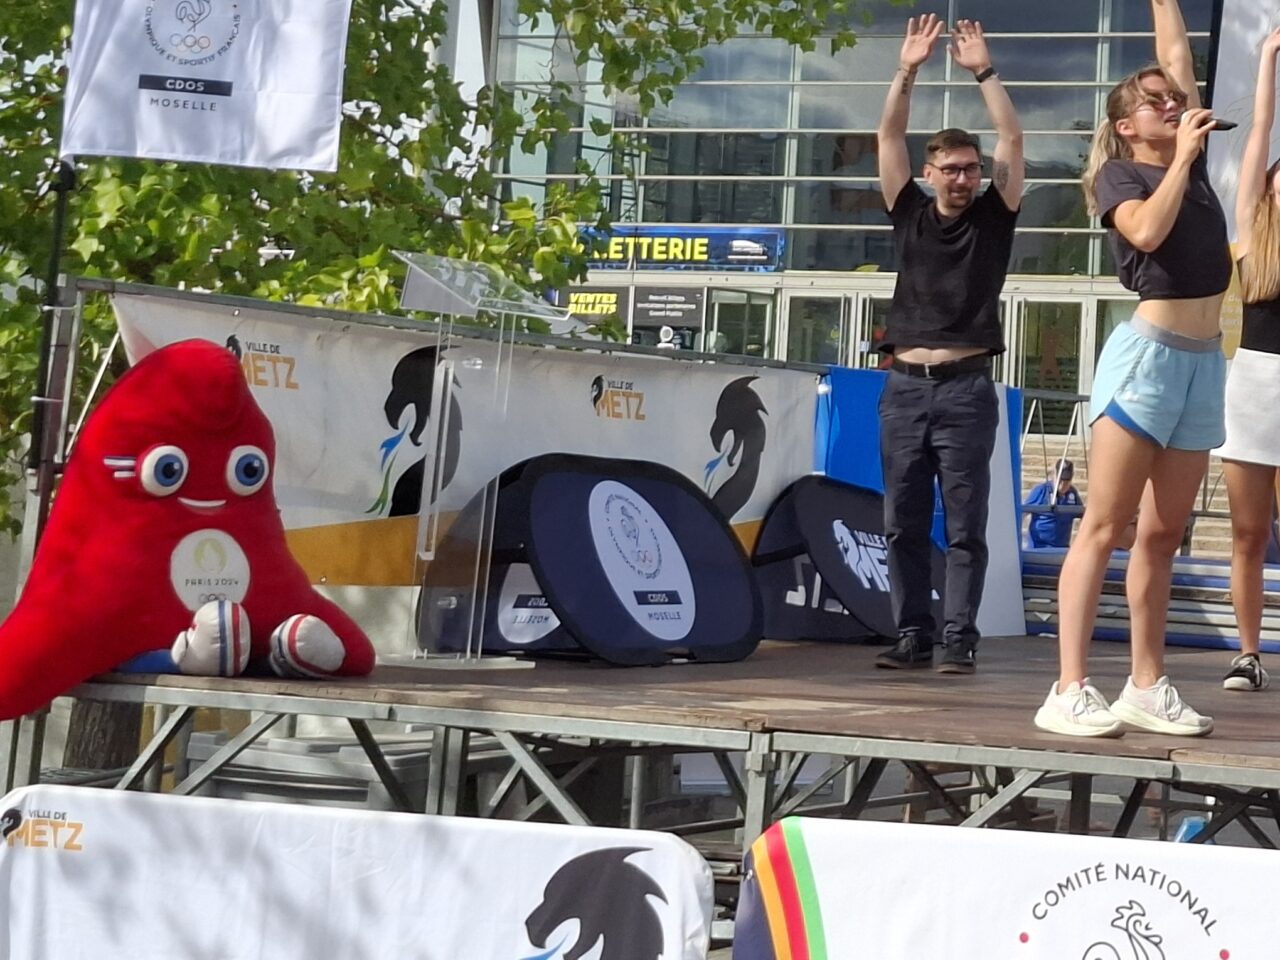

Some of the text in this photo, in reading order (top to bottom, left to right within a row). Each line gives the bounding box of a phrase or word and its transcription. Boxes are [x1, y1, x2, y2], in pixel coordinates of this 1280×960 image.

[165, 78, 205, 92] CDOS
[150, 97, 217, 112] MOSELLE
[569, 292, 618, 303] VENTES
[568, 303, 617, 315] BILLETS
[245, 341, 281, 354] VILLE DE
[608, 380, 624, 389] VILLE
[596, 389, 646, 421] METZ
[648, 611, 681, 621] MOSELLE
[29, 809, 67, 820] VILLE DE
[8, 818, 83, 851] METZ
[1032, 862, 1218, 937] COMITÉ NATIONAL
